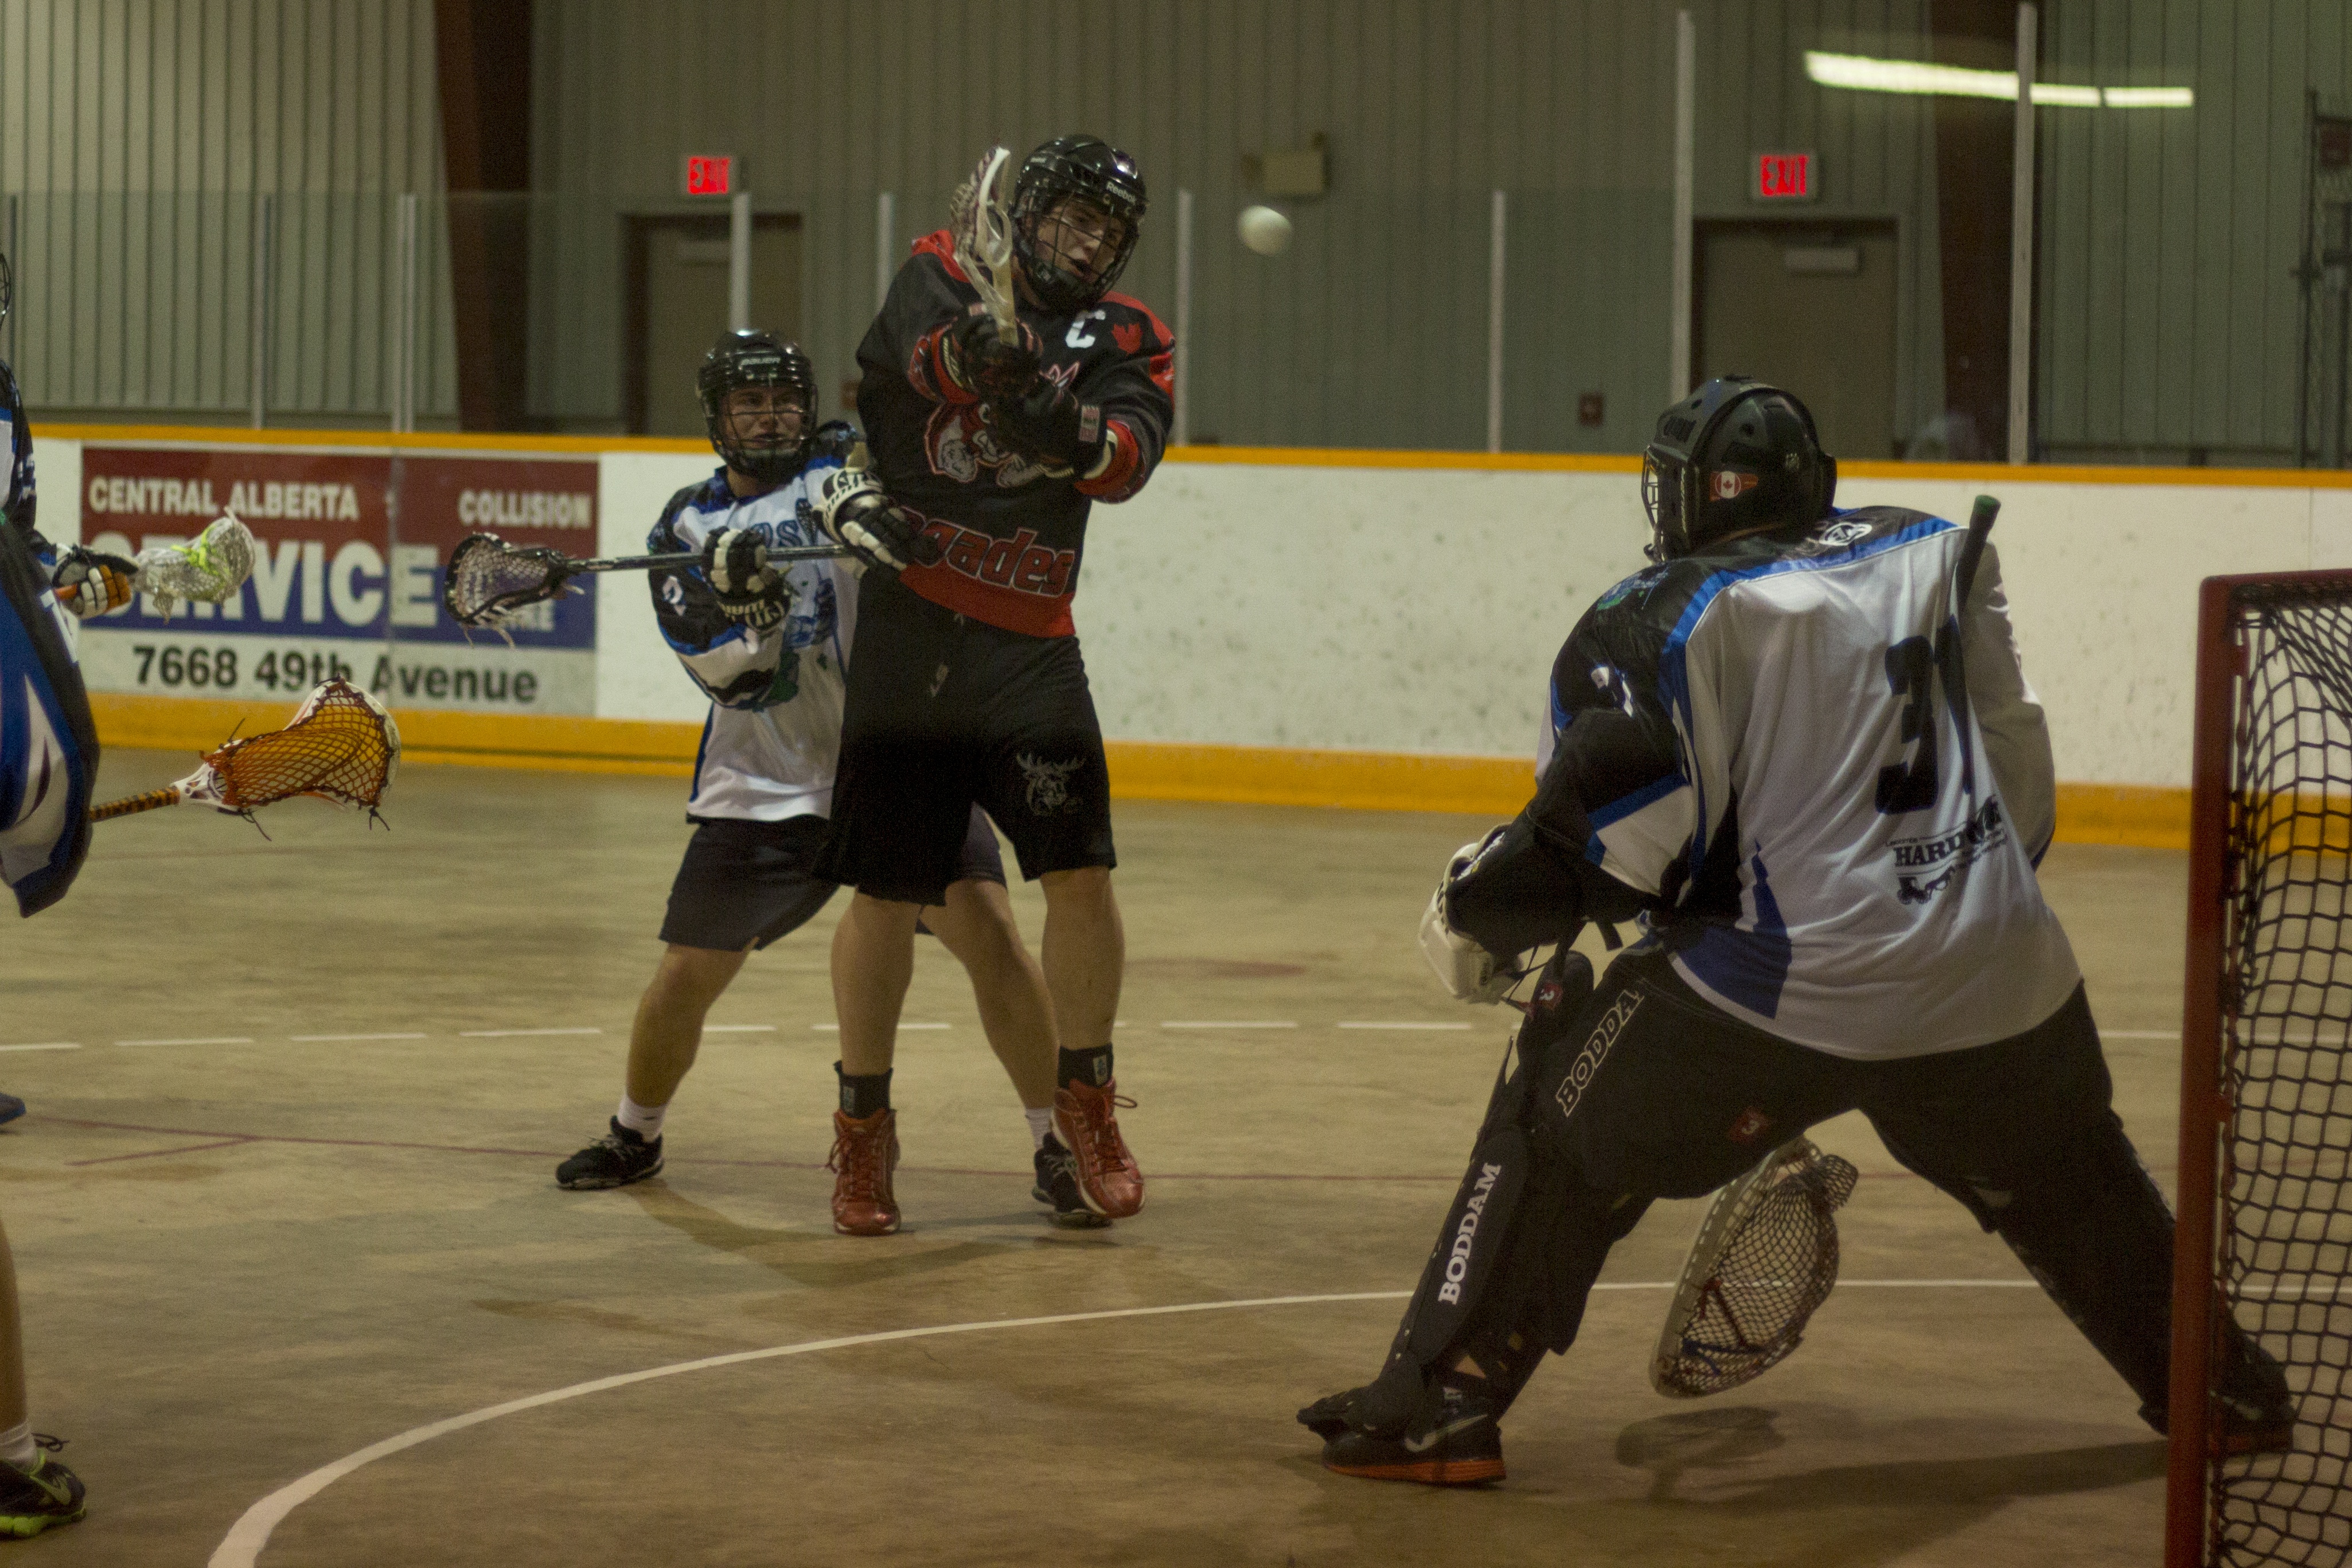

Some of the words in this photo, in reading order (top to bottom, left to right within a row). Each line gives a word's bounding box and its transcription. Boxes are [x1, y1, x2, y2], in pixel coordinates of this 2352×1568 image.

[1760, 154, 1809, 197] EXIT
[1065, 310, 1106, 348] C
[88, 476, 219, 515] CENTRAL
[230, 481, 359, 520] ALBERTA
[458, 489, 591, 529] COLLISION
[133, 645, 237, 688] 7668
[255, 649, 352, 689] 49th
[370, 654, 538, 704] Avenue
[1555, 989, 1645, 1117] BODDA
[1438, 1162, 1502, 1306] BODDAM
